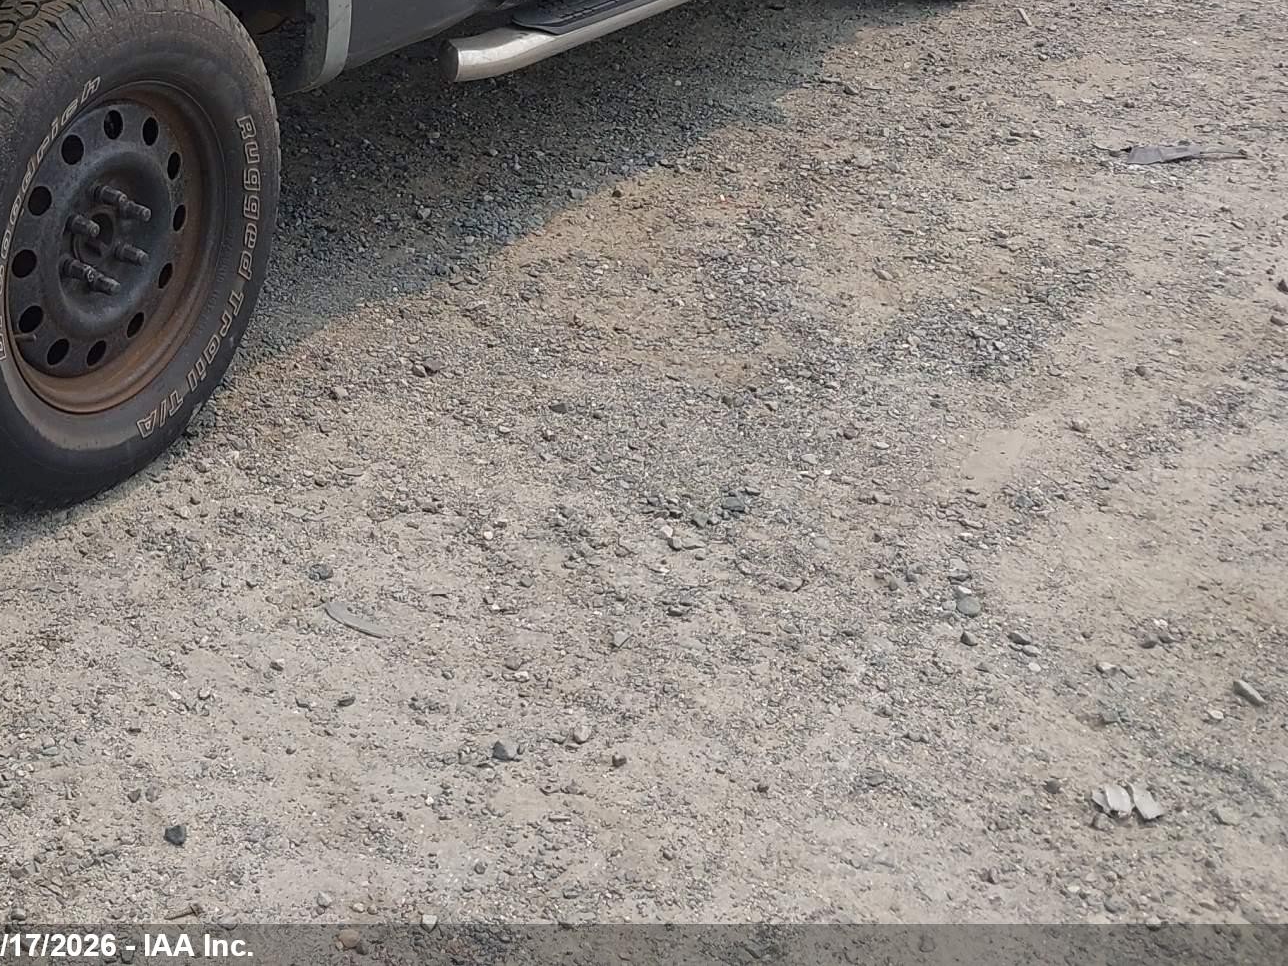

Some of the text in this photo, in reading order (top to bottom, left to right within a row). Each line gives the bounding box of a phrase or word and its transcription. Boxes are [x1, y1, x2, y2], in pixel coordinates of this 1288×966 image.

[236, 114, 261, 282] Rugged
[186, 289, 244, 392] Trail
[136, 387, 184, 438] T/A
